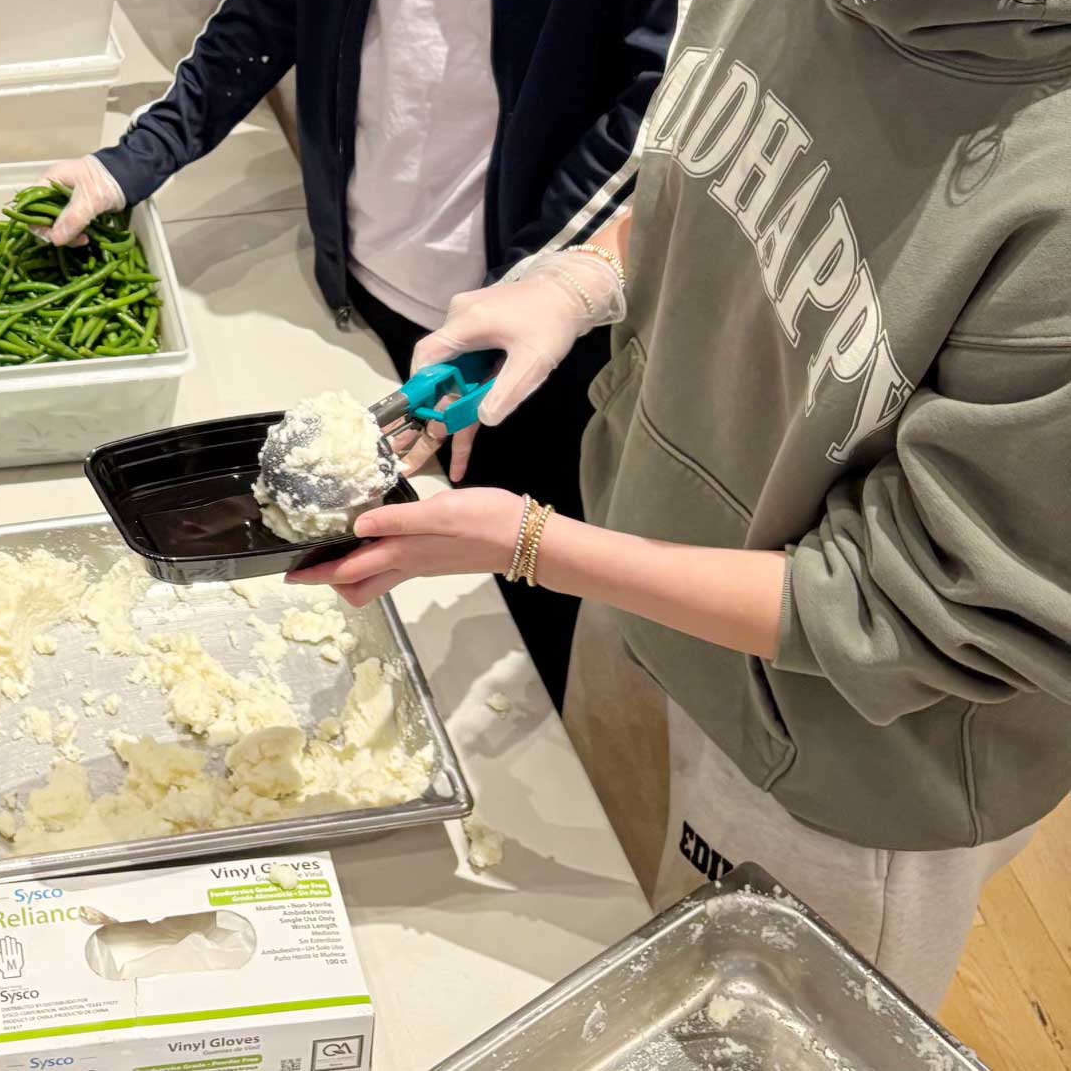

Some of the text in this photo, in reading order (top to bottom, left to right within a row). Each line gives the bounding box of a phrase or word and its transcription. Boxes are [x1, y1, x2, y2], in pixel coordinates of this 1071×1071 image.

[210, 864, 256, 879] Vinyl
[14, 888, 63, 904] Sysco
[6, 958, 18, 971] M
[0, 989, 39, 1004] Sysco
[167, 1035, 260, 1052] Vinyl Gloves
[29, 1056, 74, 1070] Sysco
